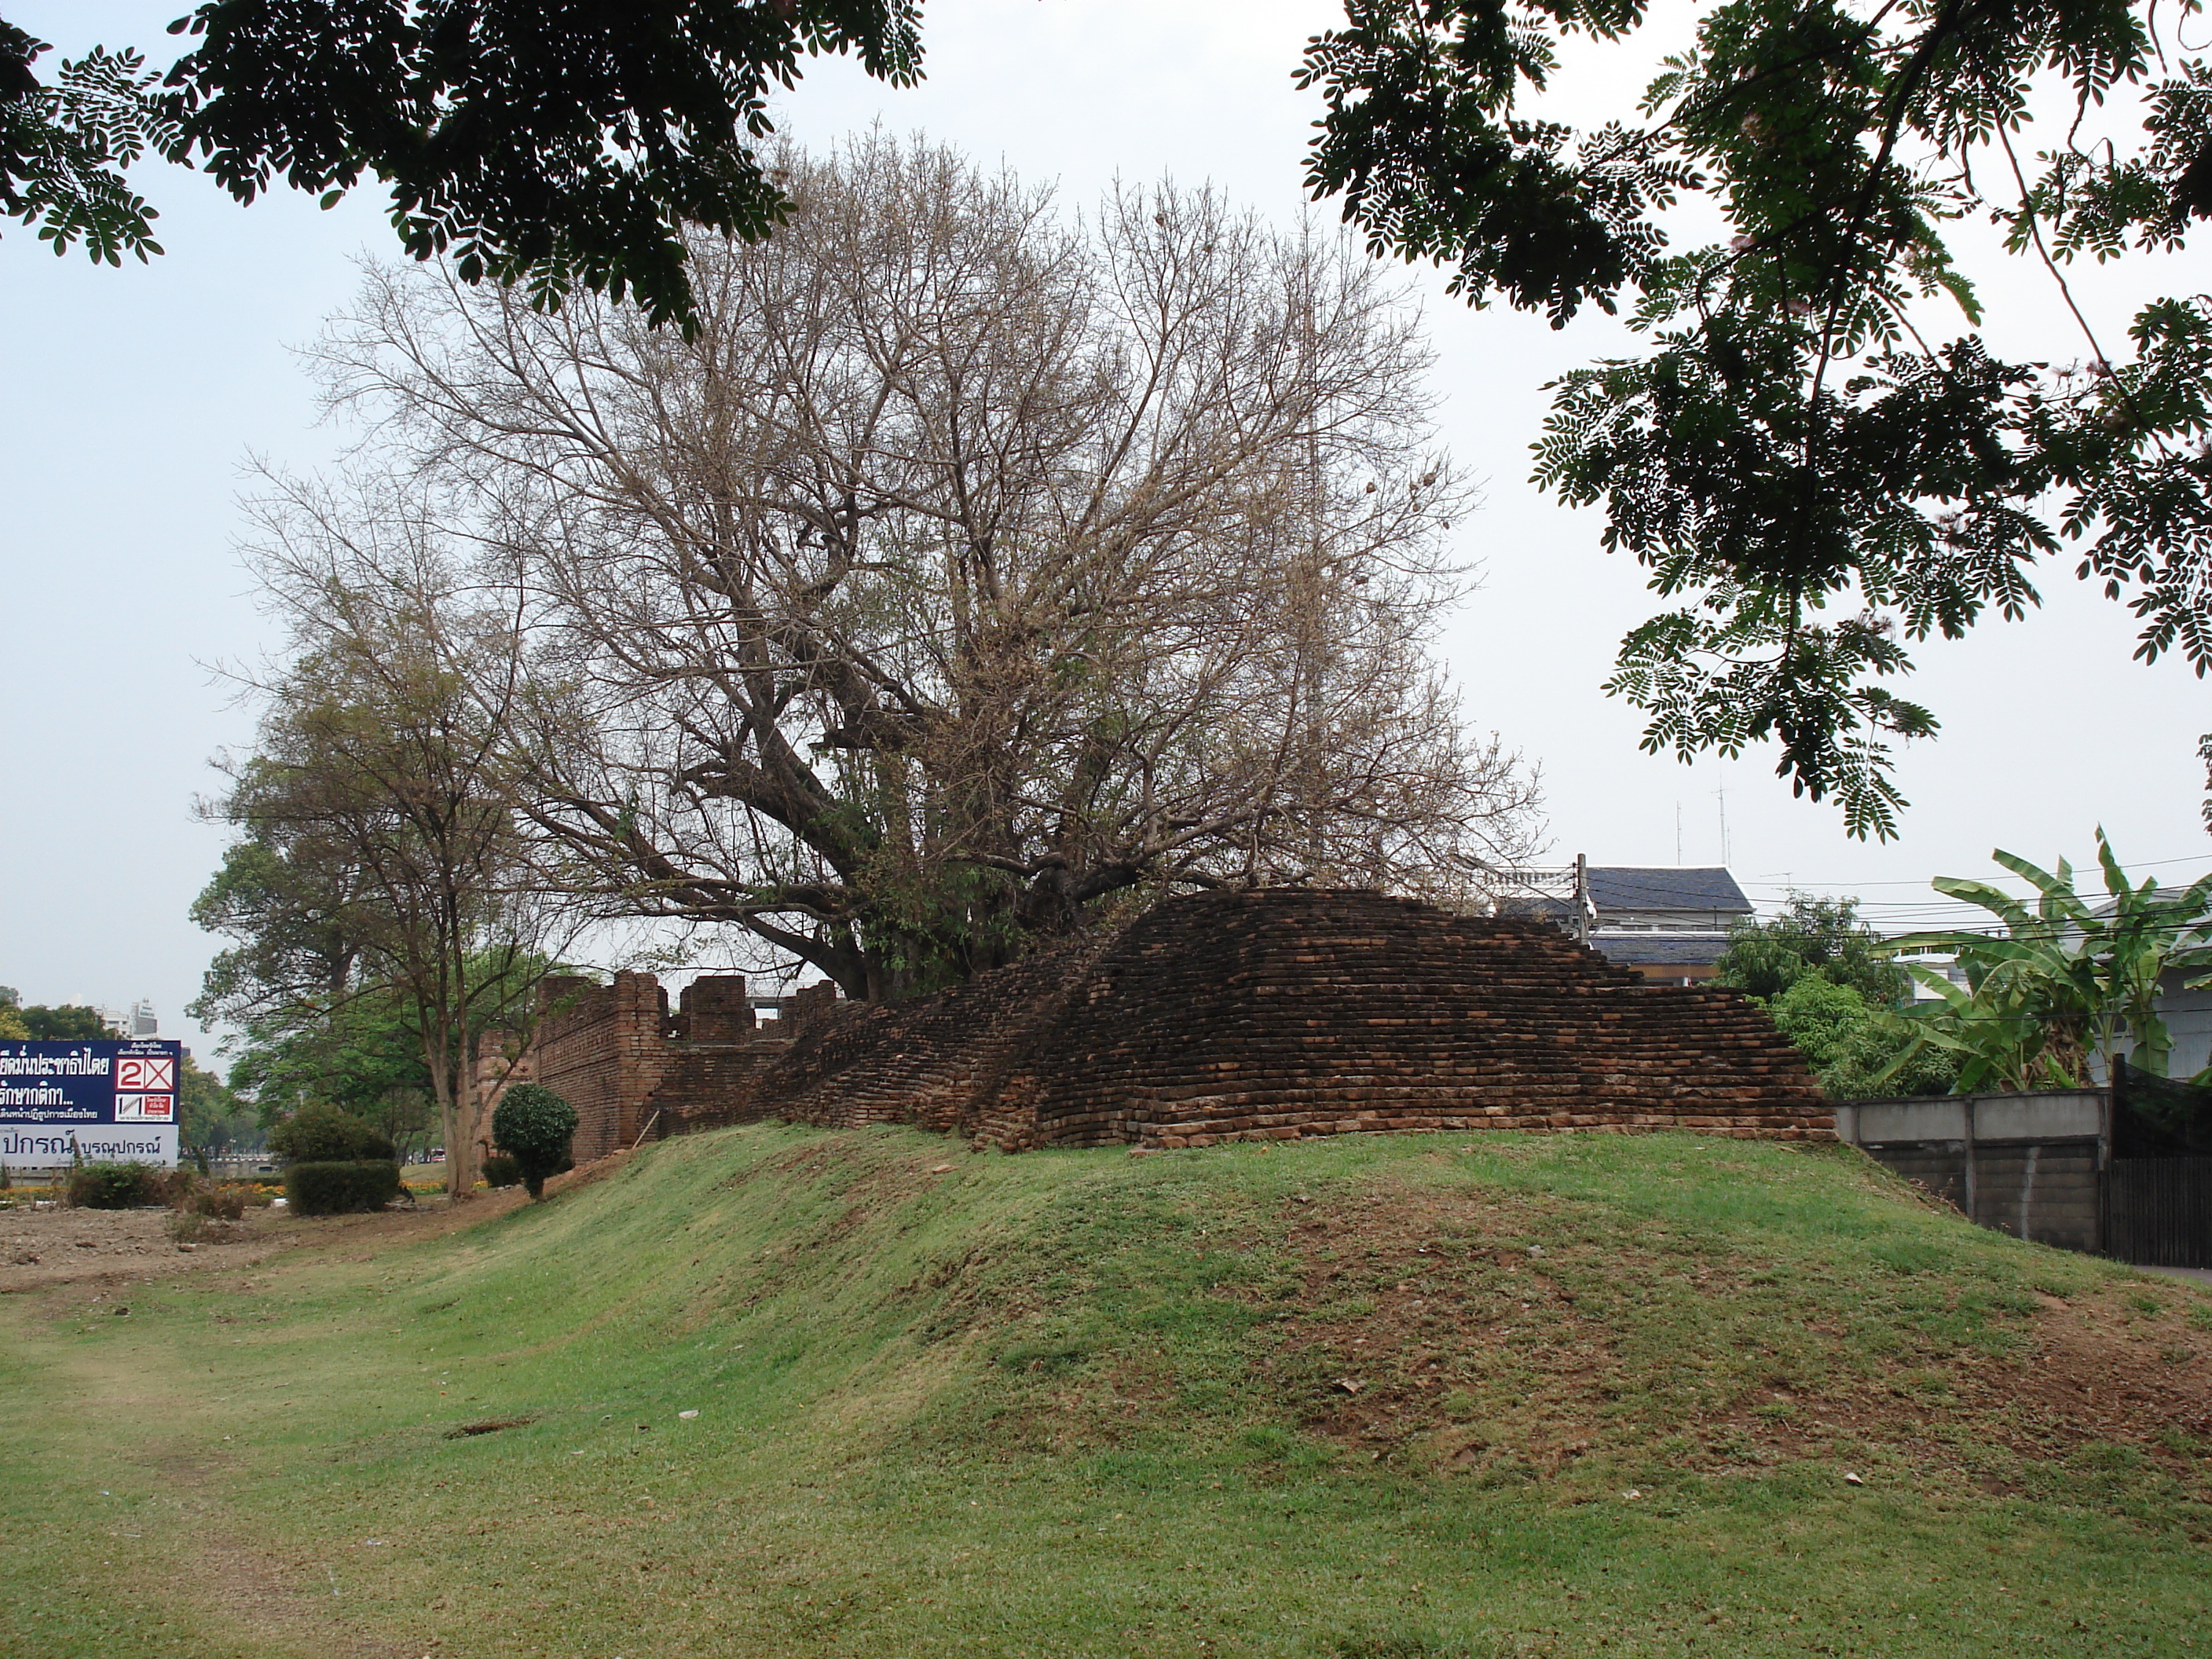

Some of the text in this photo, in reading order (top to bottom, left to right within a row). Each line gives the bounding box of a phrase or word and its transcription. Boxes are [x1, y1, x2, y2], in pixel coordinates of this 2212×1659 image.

[121, 1062, 142, 1086] 2
[0, 1107, 97, 1122] ดินหน้าปฏิรูปการเมืองไทย
[3, 1129, 75, 1154] ปกรณ์
